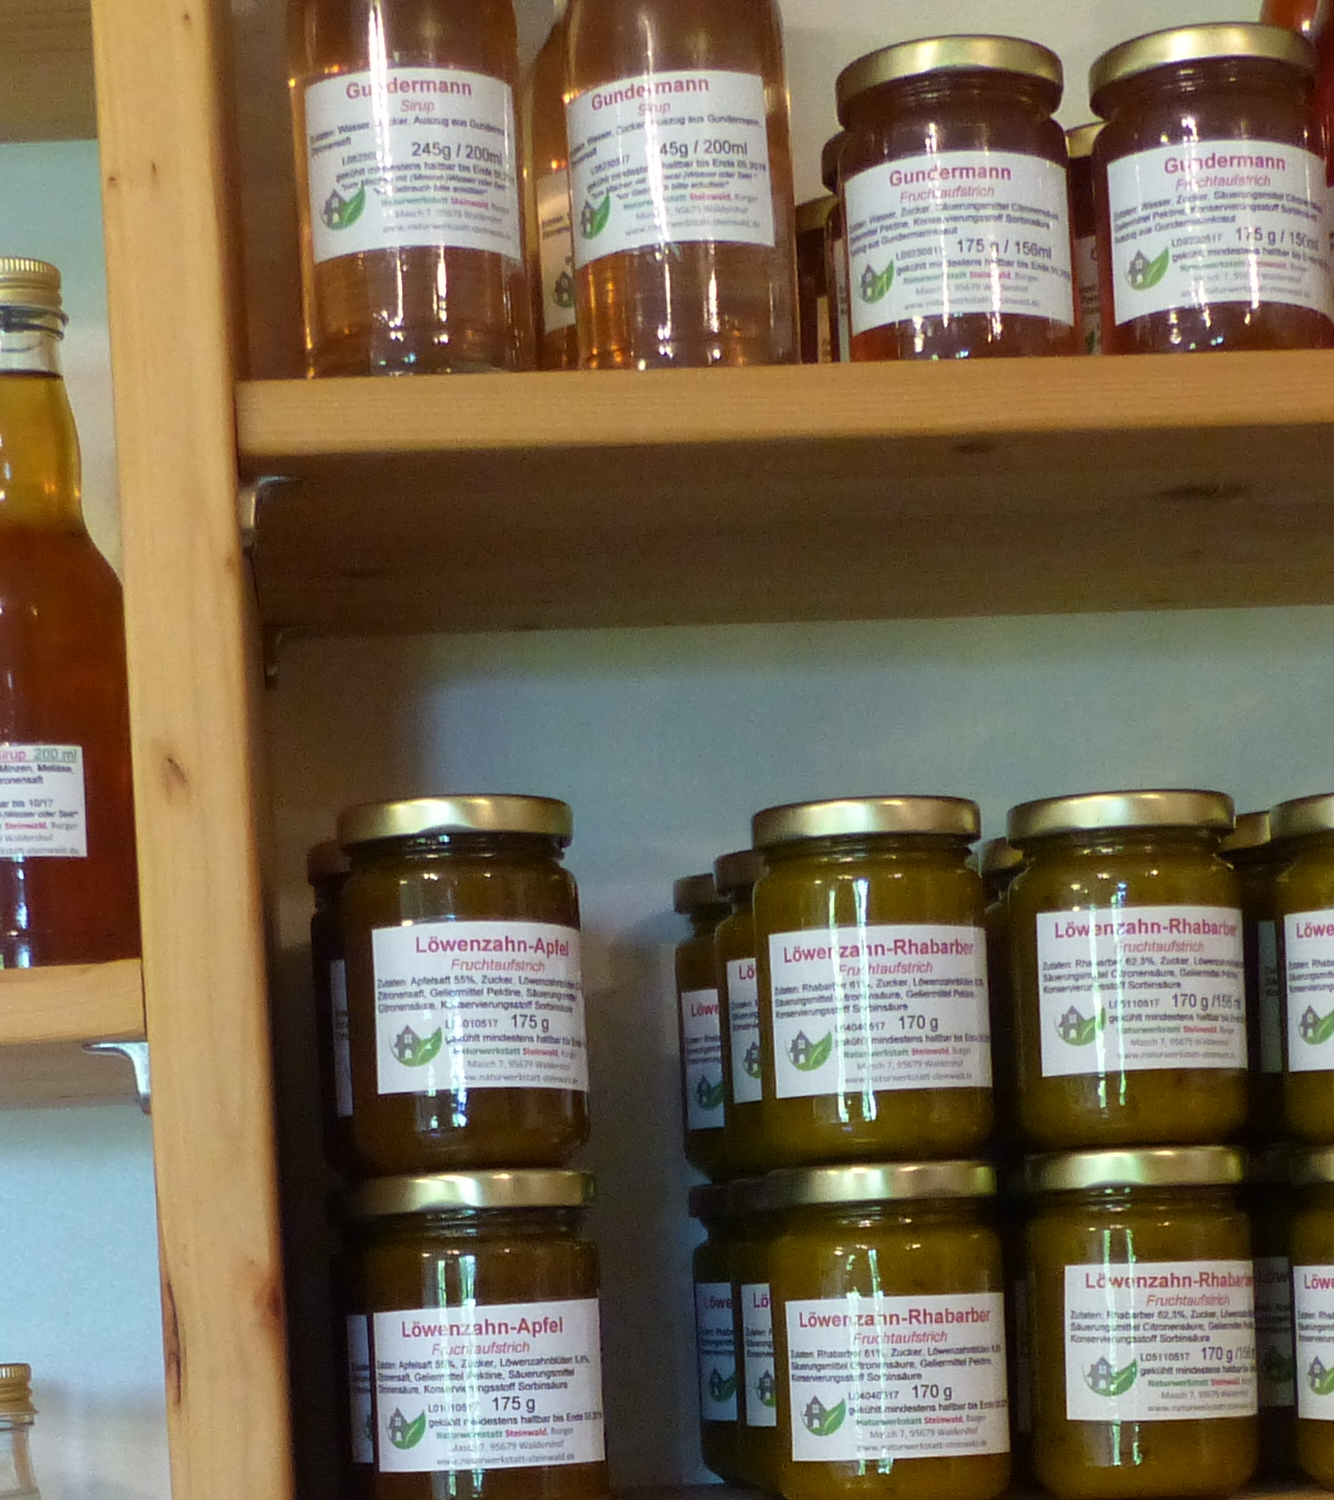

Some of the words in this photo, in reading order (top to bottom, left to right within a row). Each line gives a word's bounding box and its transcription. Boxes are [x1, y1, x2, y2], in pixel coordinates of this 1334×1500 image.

[346, 77, 472, 99] Gudermann
[592, 79, 709, 110] Gundemann
[401, 100, 435, 114] Sirup
[638, 103, 671, 115] Srup
[412, 142, 452, 160] 245g
[466, 145, 502, 166] 200ml
[704, 140, 747, 155] 200ml
[890, 166, 1011, 187] Gundermann
[901, 186, 995, 203] Fruchaufstrich
[1268, 231, 1276, 245] g
[957, 239, 985, 253] 175
[1014, 240, 1051, 260] 156ml
[34, 749, 58, 760] 200
[63, 749, 77, 761] ml
[416, 936, 569, 958] Löwenzahn-Apfel
[451, 958, 545, 973] Fruchtaufstrich
[1172, 994, 1197, 1008] 170
[1201, 996, 1208, 1011] g
[511, 1014, 537, 1029] 175
[541, 1018, 549, 1032] g
[898, 1015, 926, 1030] 170
[930, 1018, 938, 1032] g
[1147, 1294, 1230, 1307] Fruchtaufstrich
[402, 1316, 563, 1338] Löwenzahn-Apfel
[854, 1331, 947, 1346] Fruchtaufstrich
[1201, 1347, 1223, 1361] 170
[1226, 1349, 1233, 1362] g
[911, 1385, 939, 1398] 170
[944, 1386, 952, 1401] g
[492, 1398, 521, 1411] 175
[526, 1399, 535, 1413] g
